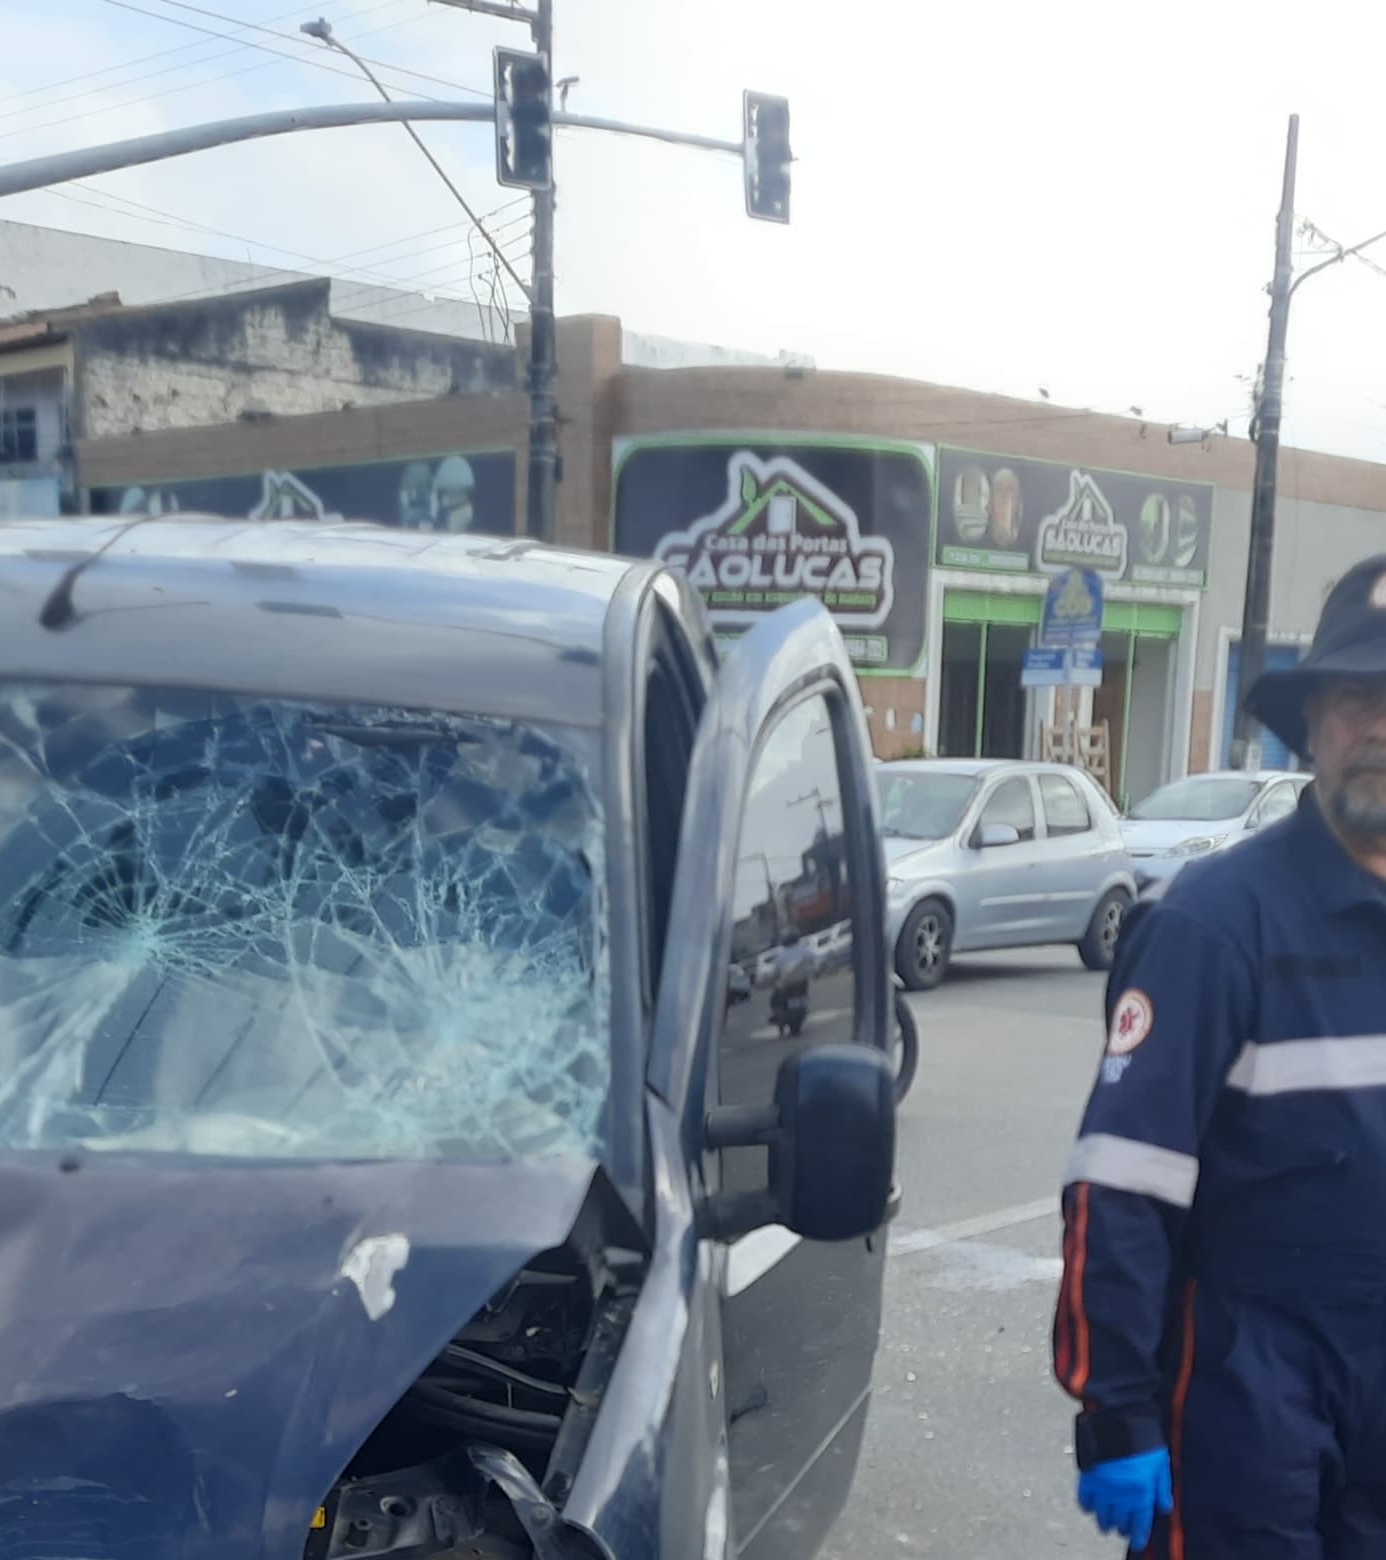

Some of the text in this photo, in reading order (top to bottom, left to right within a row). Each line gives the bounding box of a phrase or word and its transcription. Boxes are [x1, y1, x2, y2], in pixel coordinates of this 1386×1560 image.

[705, 534, 848, 553] Casa das Portas
